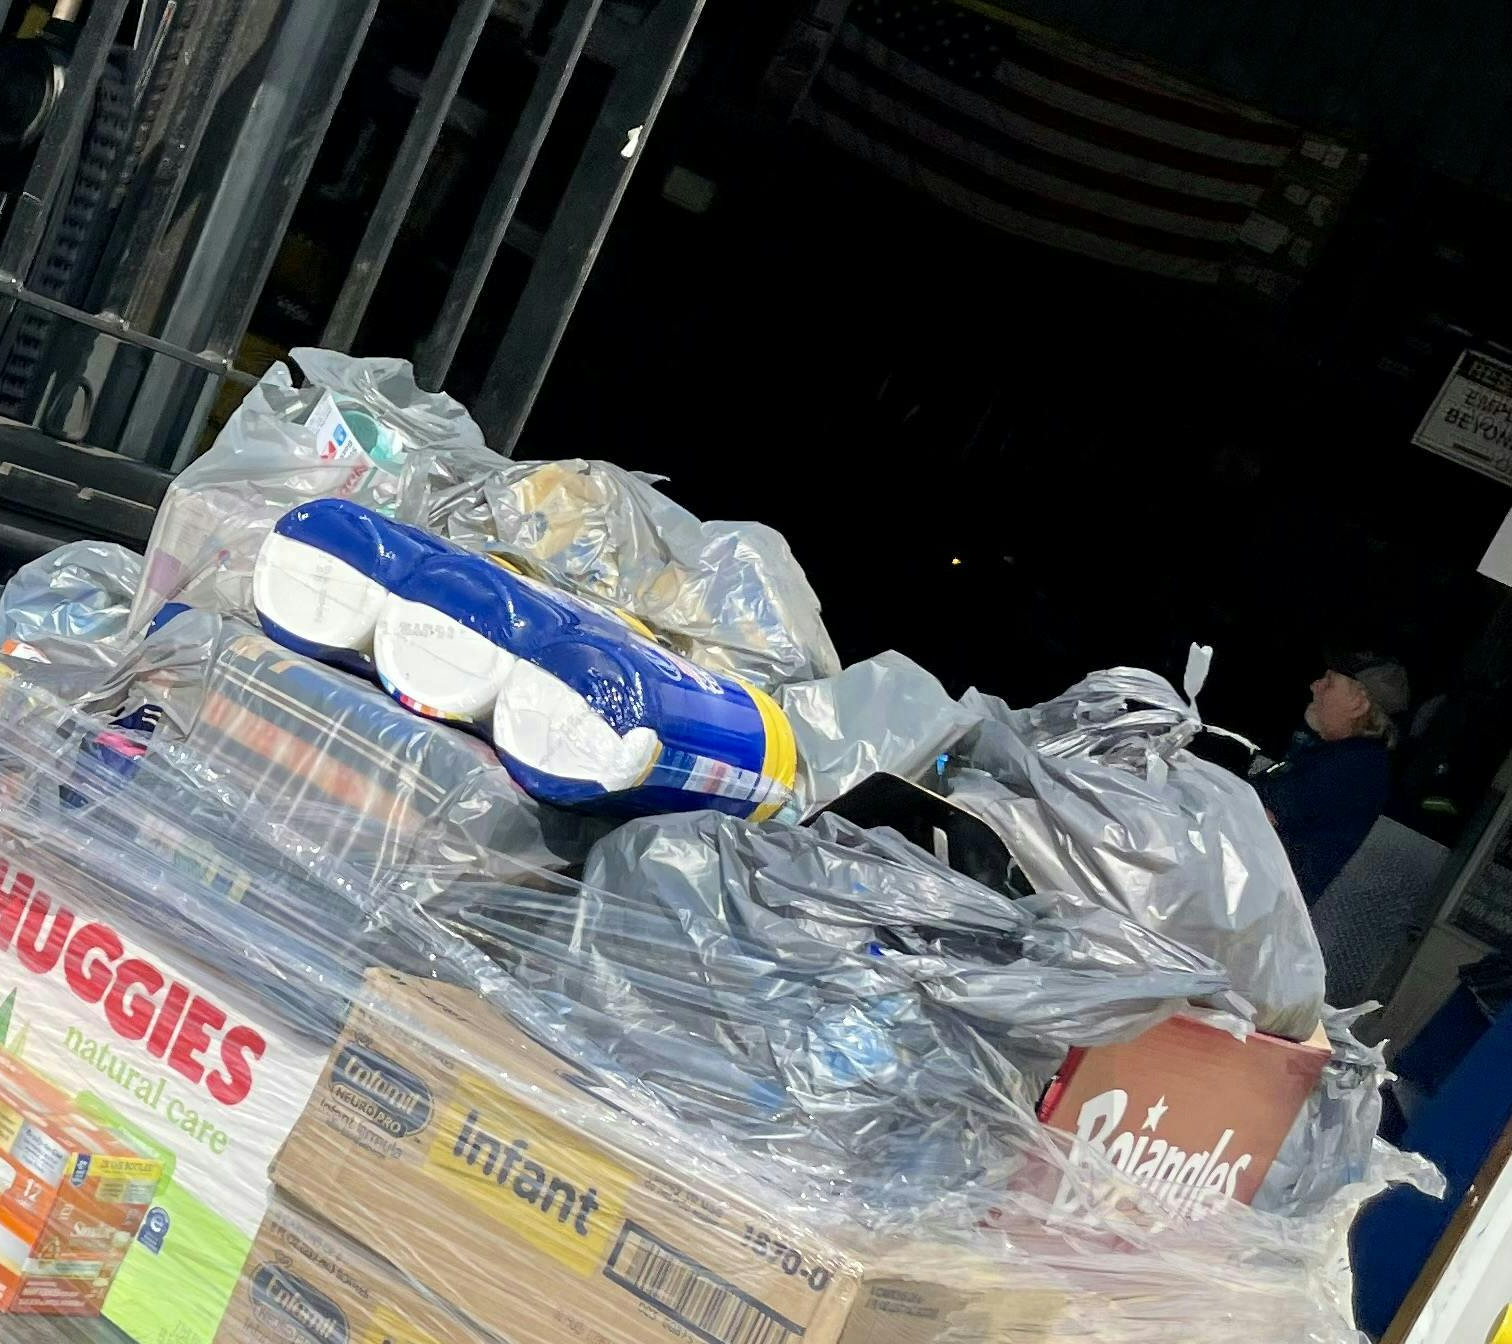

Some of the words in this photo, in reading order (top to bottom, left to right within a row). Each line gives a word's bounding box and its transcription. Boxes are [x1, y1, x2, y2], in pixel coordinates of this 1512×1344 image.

[62, 1024, 166, 1110] natural
[165, 1090, 231, 1156] care
[451, 1108, 601, 1239] Infant
